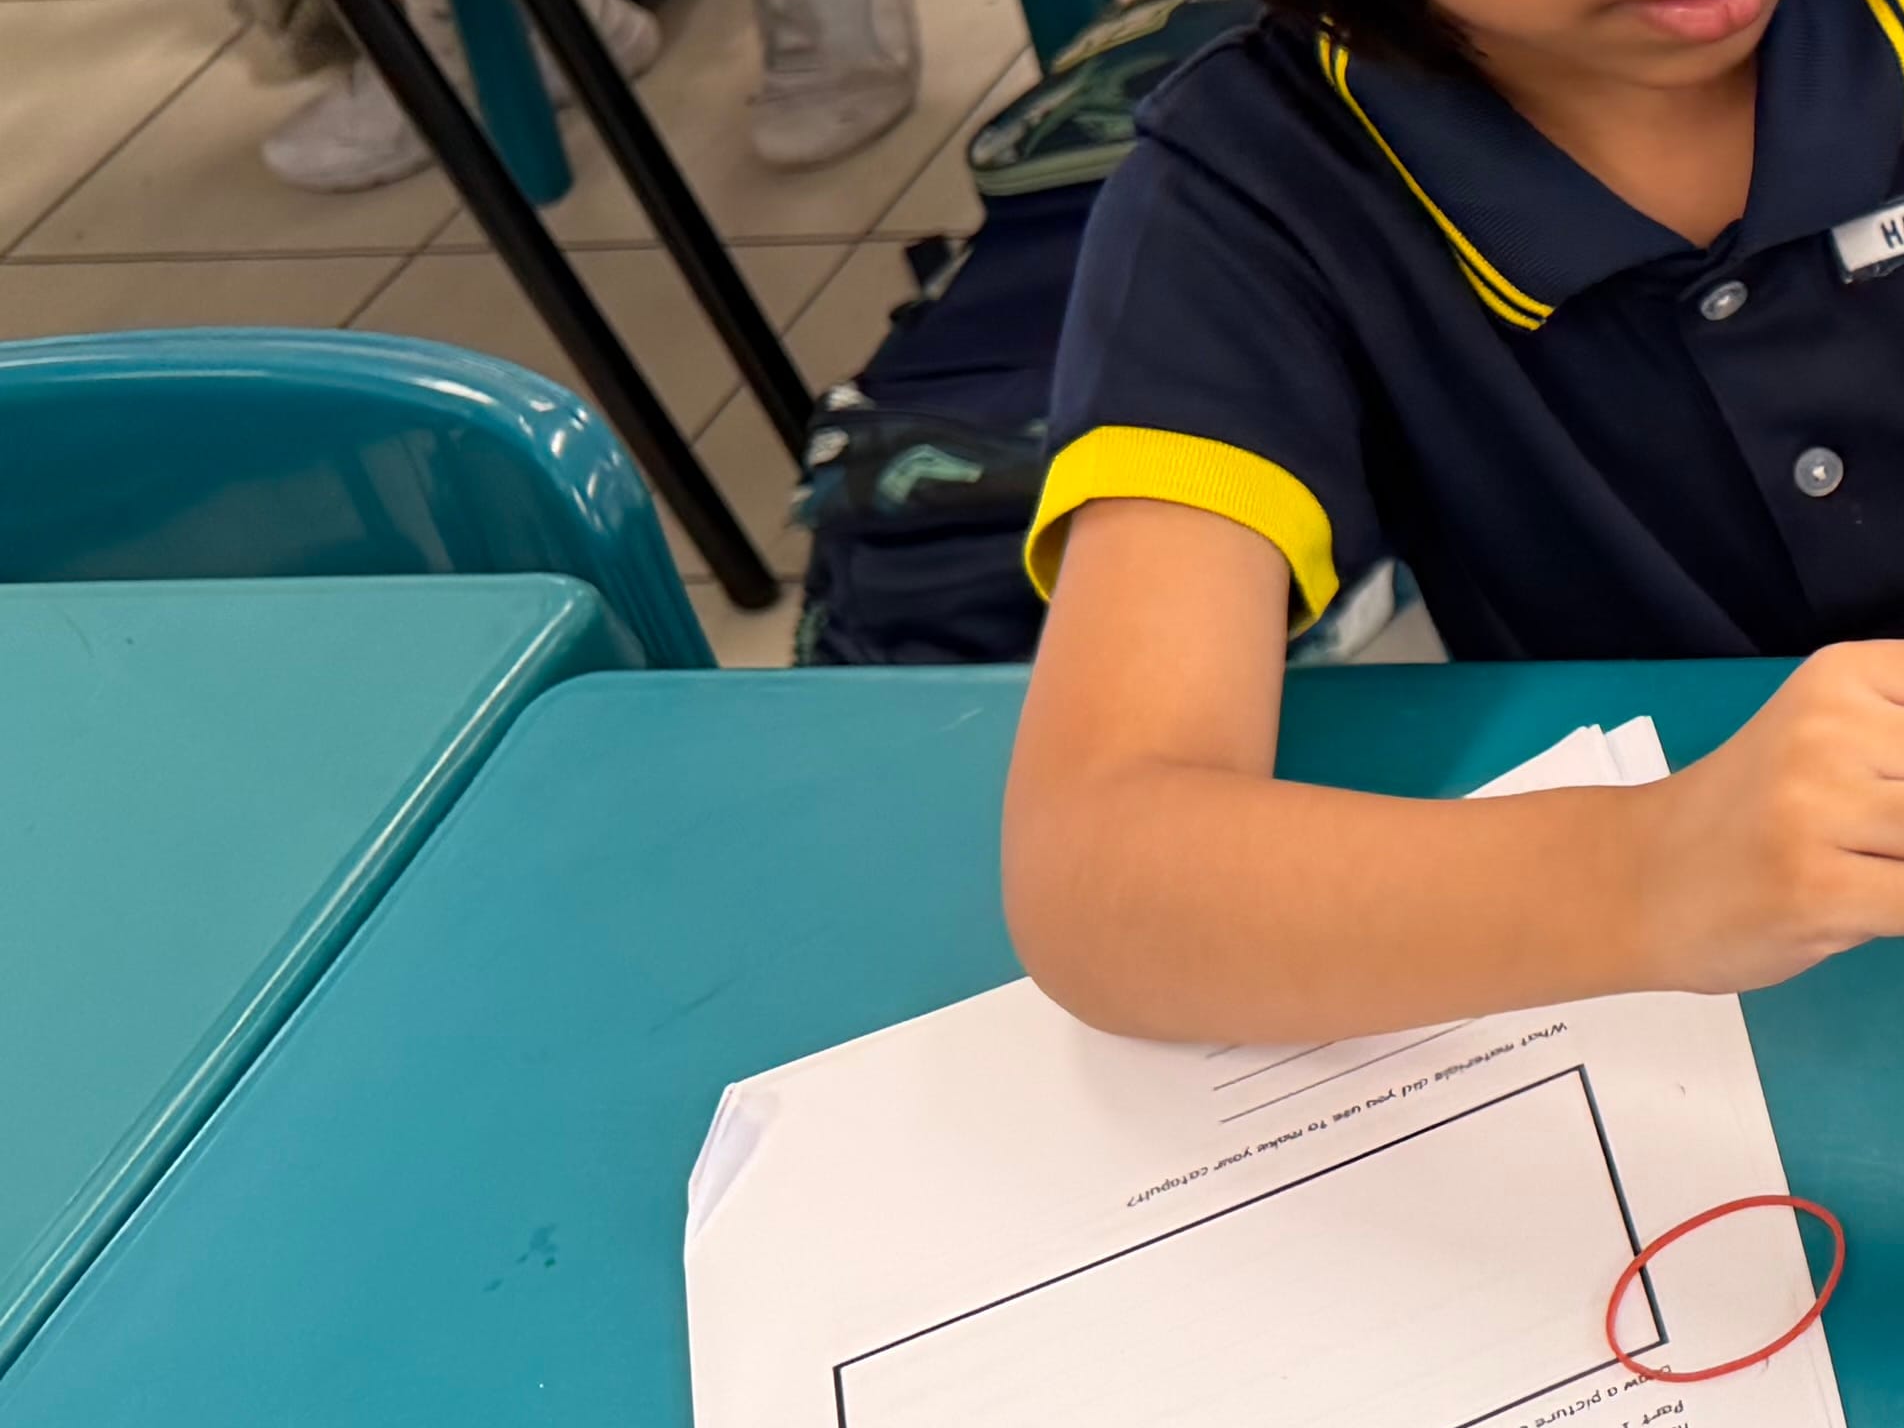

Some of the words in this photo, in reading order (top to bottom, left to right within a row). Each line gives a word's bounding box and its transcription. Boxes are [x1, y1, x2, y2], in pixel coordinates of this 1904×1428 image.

[1520, 1022, 1568, 1047] What
[1434, 1043, 1515, 1082] materials
[1365, 1088, 1397, 1109] you
[1401, 1077, 1429, 1098] did
[1307, 1119, 1328, 1132] to
[1332, 1105, 1362, 1123] use
[1256, 1128, 1303, 1153] make
[1213, 1146, 1253, 1171] your
[1126, 1166, 1209, 1208] catapult?
[1606, 1386, 1618, 1398] a
[1535, 1389, 1602, 1428] picture
[1642, 1399, 1684, 1425] Part
